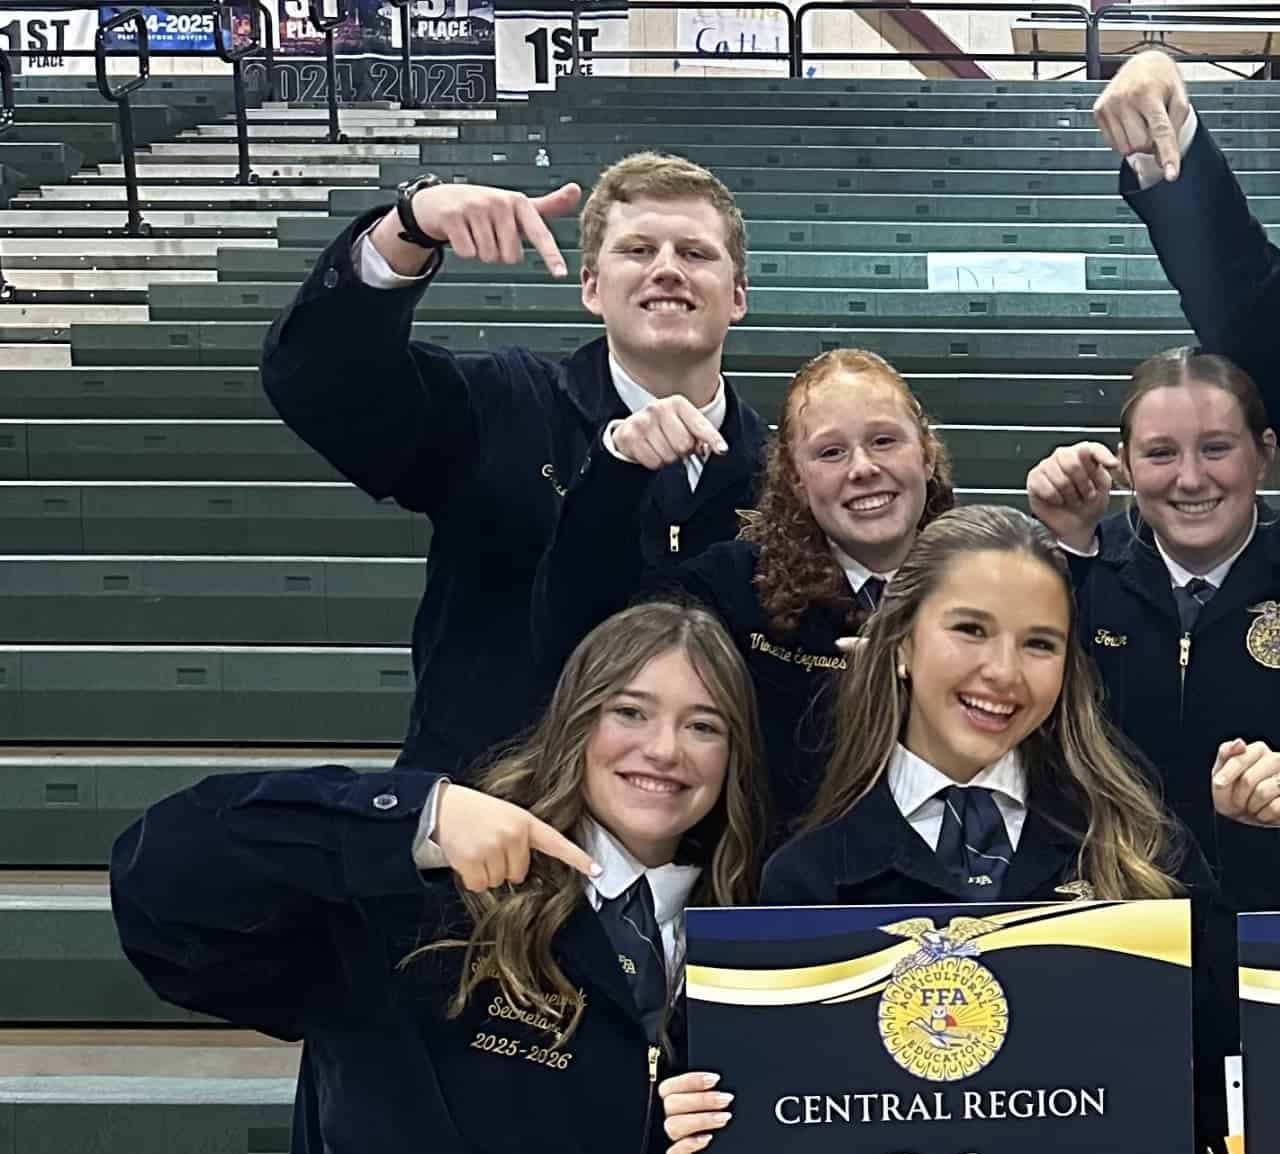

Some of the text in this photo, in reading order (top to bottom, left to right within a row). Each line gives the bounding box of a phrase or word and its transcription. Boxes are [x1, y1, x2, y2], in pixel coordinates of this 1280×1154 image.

[286, 20, 338, 38] PLA
[417, 21, 468, 38] PLACE
[28, 55, 65, 69] PLACE
[525, 27, 599, 84] 1ST
[370, 62, 487, 105] 2025
[920, 988, 969, 1006] FFA
[470, 1032, 573, 1070] 2025-2026
[905, 1036, 982, 1063] EDUCATION
[775, 1087, 1105, 1125] CENTRAL REGION
